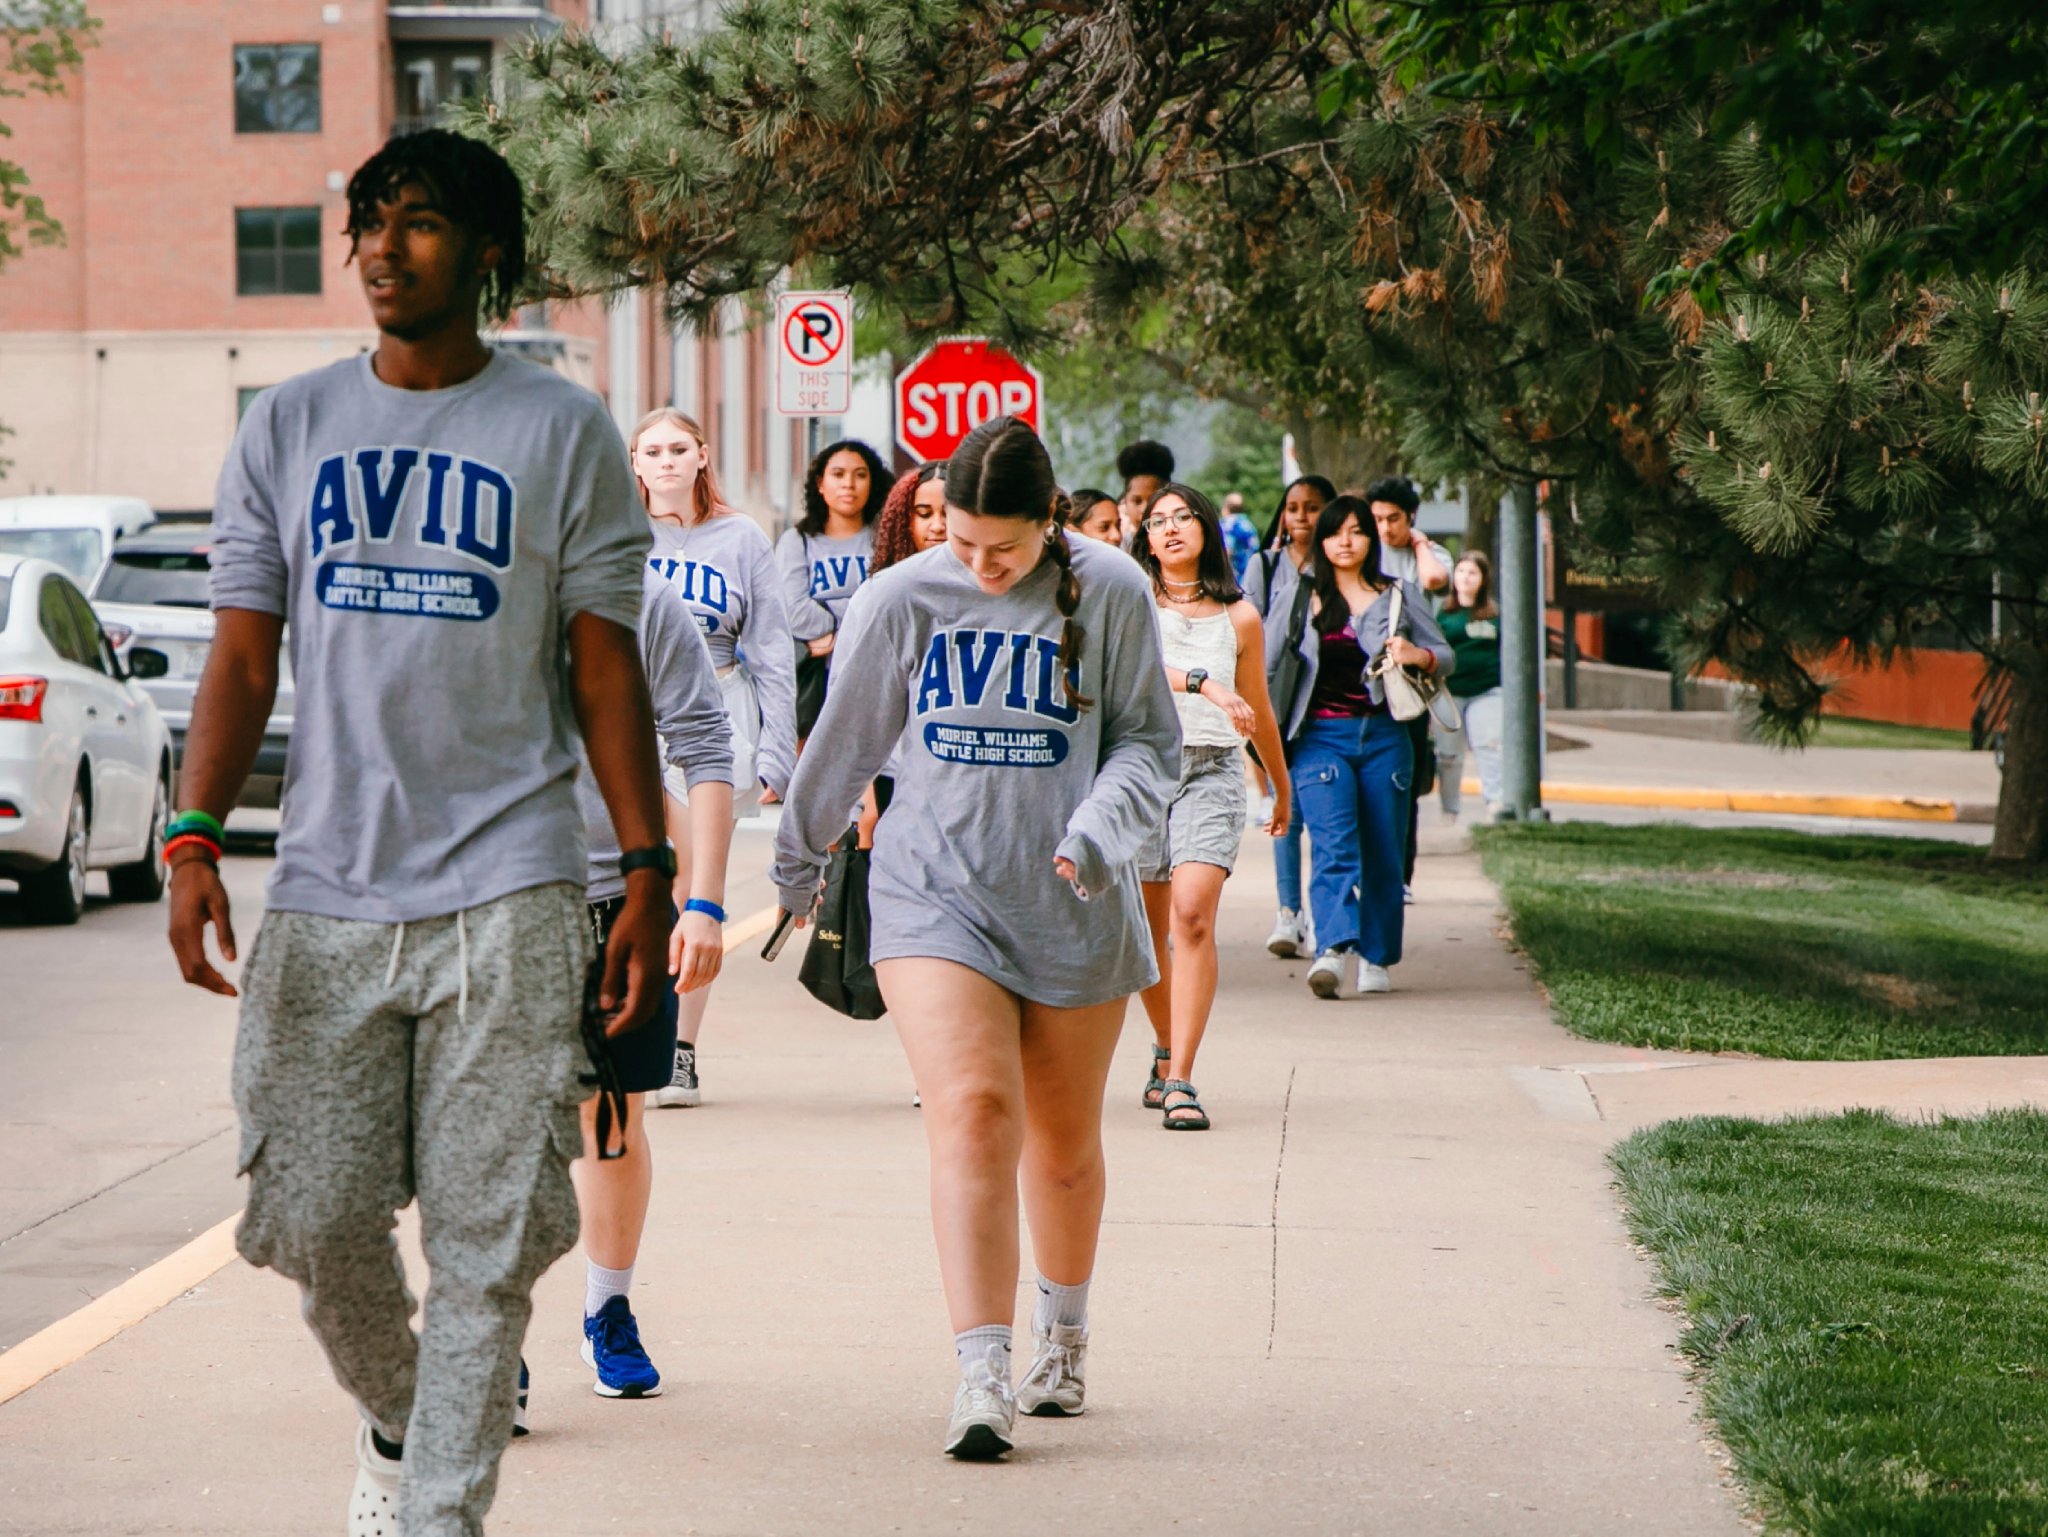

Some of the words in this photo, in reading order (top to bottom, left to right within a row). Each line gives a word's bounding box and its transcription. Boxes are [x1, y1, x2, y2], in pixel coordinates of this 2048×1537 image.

[799, 371, 829, 386] THIS
[798, 391, 829, 406] SIDE
[906, 380, 1033, 438] STOP
[307, 446, 516, 573] AVID
[392, 571, 472, 596] WILLIAMS
[647, 557, 728, 614] VID
[809, 556, 868, 598] AVI
[421, 593, 483, 616] SCHOOL
[916, 628, 1082, 727] AVID
[936, 727, 980, 745] MURIEL
[984, 731, 1047, 747] WILLIAMS
[931, 741, 972, 760] BATTLE
[975, 749, 1005, 762] HIGH
[1008, 749, 1055, 763] SCHOOL
[818, 929, 842, 941] Scho
